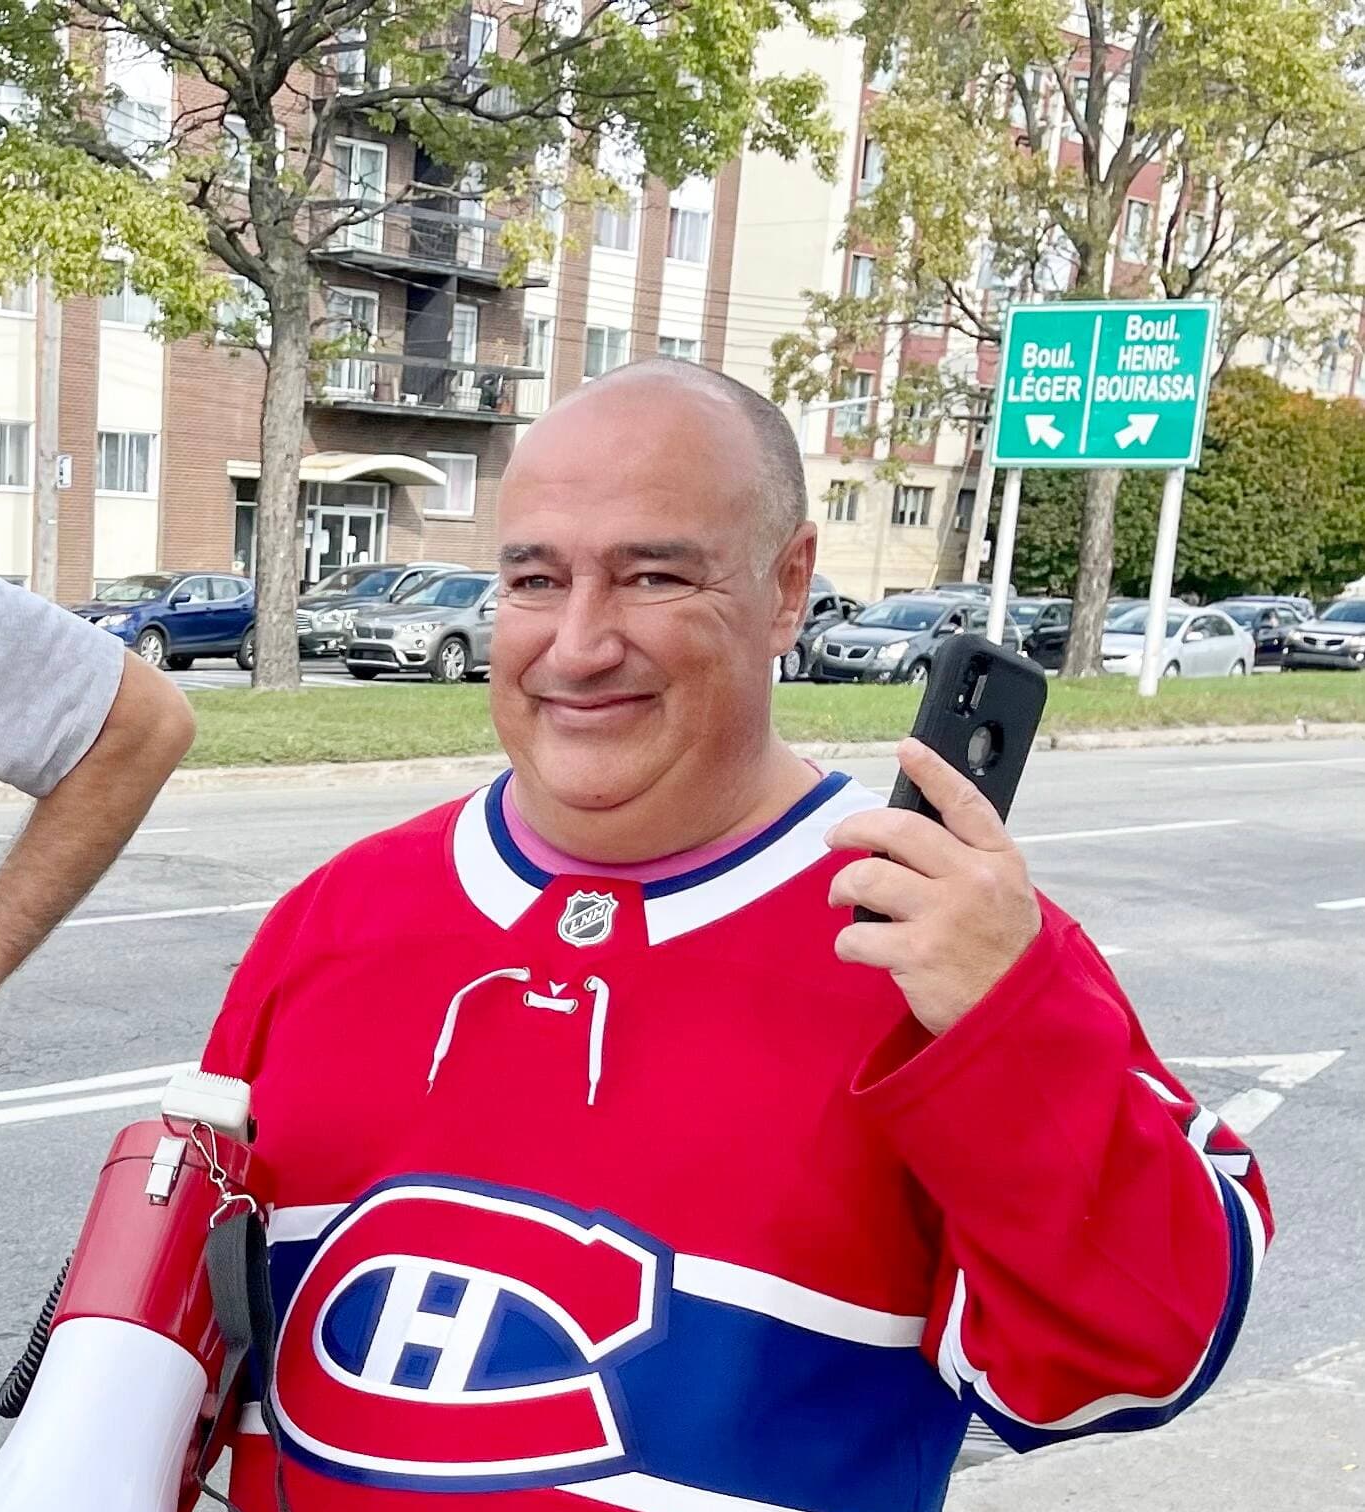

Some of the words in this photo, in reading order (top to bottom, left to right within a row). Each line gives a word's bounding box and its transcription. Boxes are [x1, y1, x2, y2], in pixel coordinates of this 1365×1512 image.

[1125, 314, 1181, 342] Boul.
[1021, 342, 1075, 369] Boul.
[1117, 344, 1181, 371] HENRI-
[1007, 369, 1083, 403] LÉGER
[1094, 374, 1196, 402] BOURASSA
